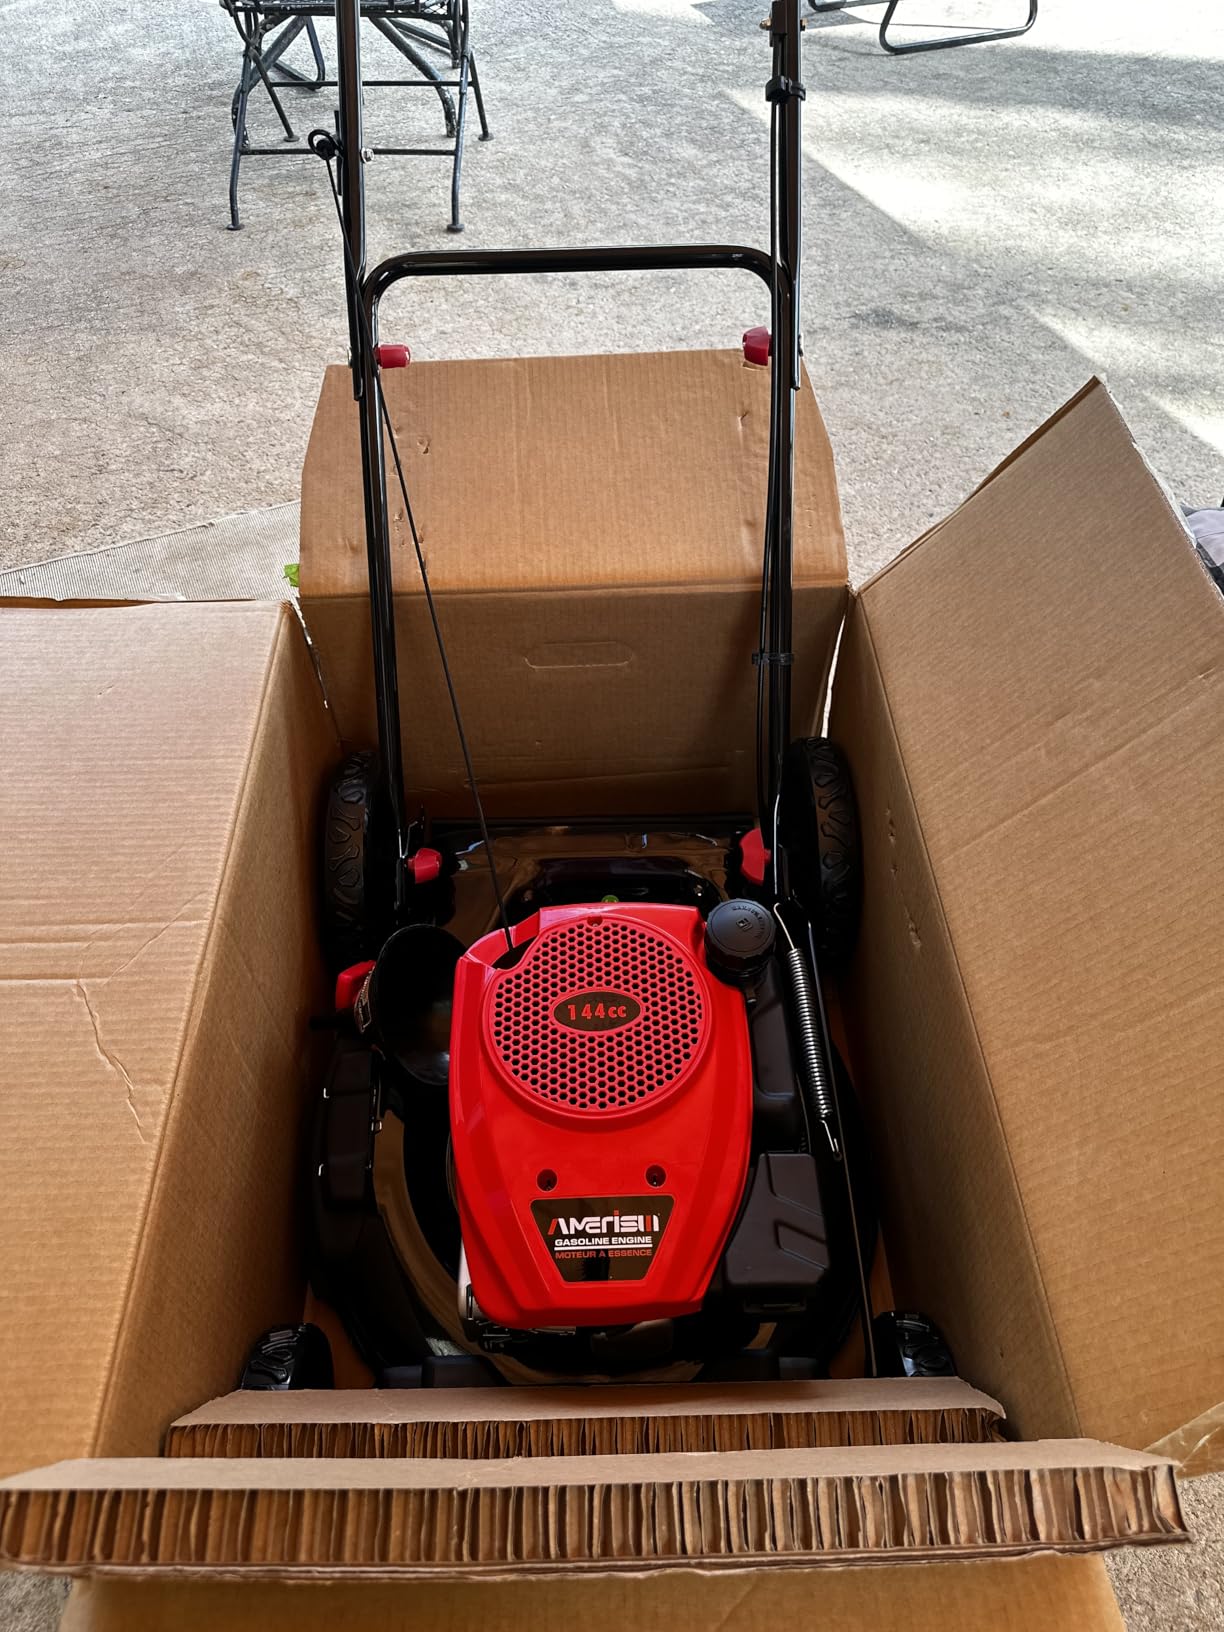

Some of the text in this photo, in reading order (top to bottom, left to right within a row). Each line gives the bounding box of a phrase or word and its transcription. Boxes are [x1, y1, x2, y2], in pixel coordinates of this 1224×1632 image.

[567, 1003, 627, 1020] 144cc
[554, 1236, 653, 1246] GASOLINE ENGINE
[555, 1250, 597, 1259] MOTEUR
[608, 1249, 653, 1257] ESSENCE
